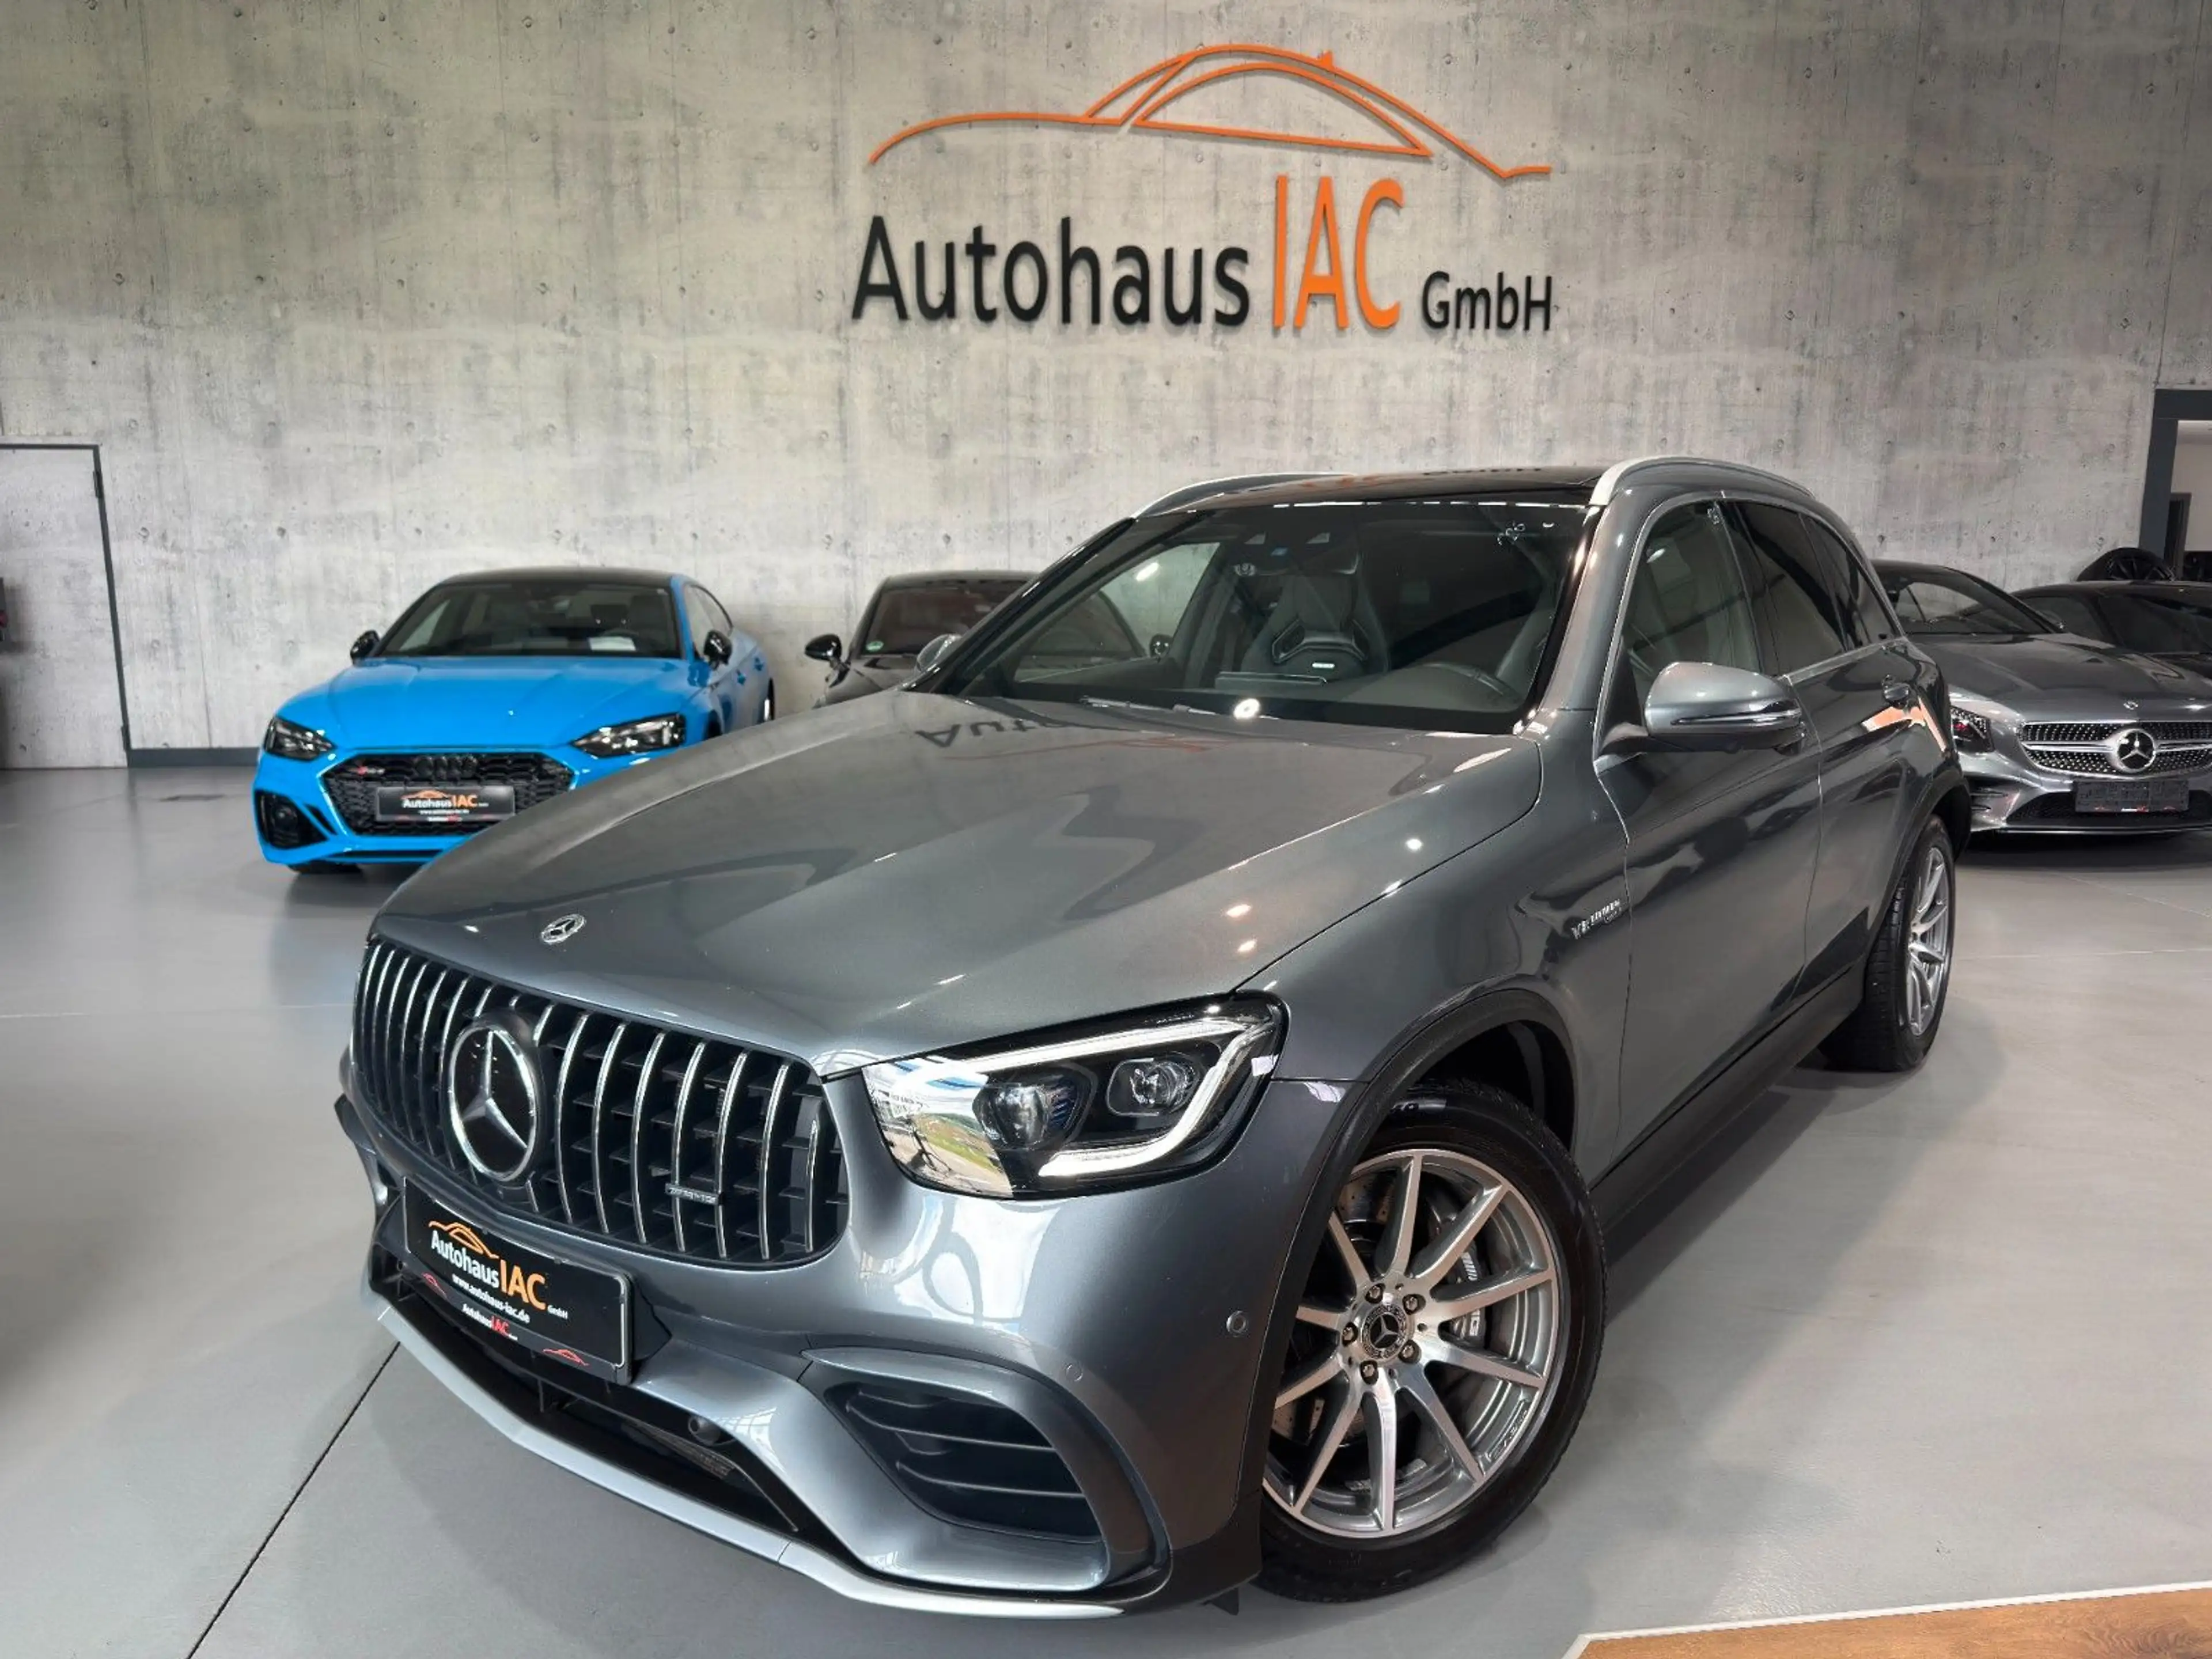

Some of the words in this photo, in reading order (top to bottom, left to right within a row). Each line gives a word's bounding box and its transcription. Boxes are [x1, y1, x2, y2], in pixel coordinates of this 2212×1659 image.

[851, 215, 1251, 326] Autohaus
[1272, 173, 1404, 331] IAC
[1421, 271, 1552, 332] GmbH
[431, 1230, 499, 1289] Autohaus
[500, 1259, 547, 1310] IAC
